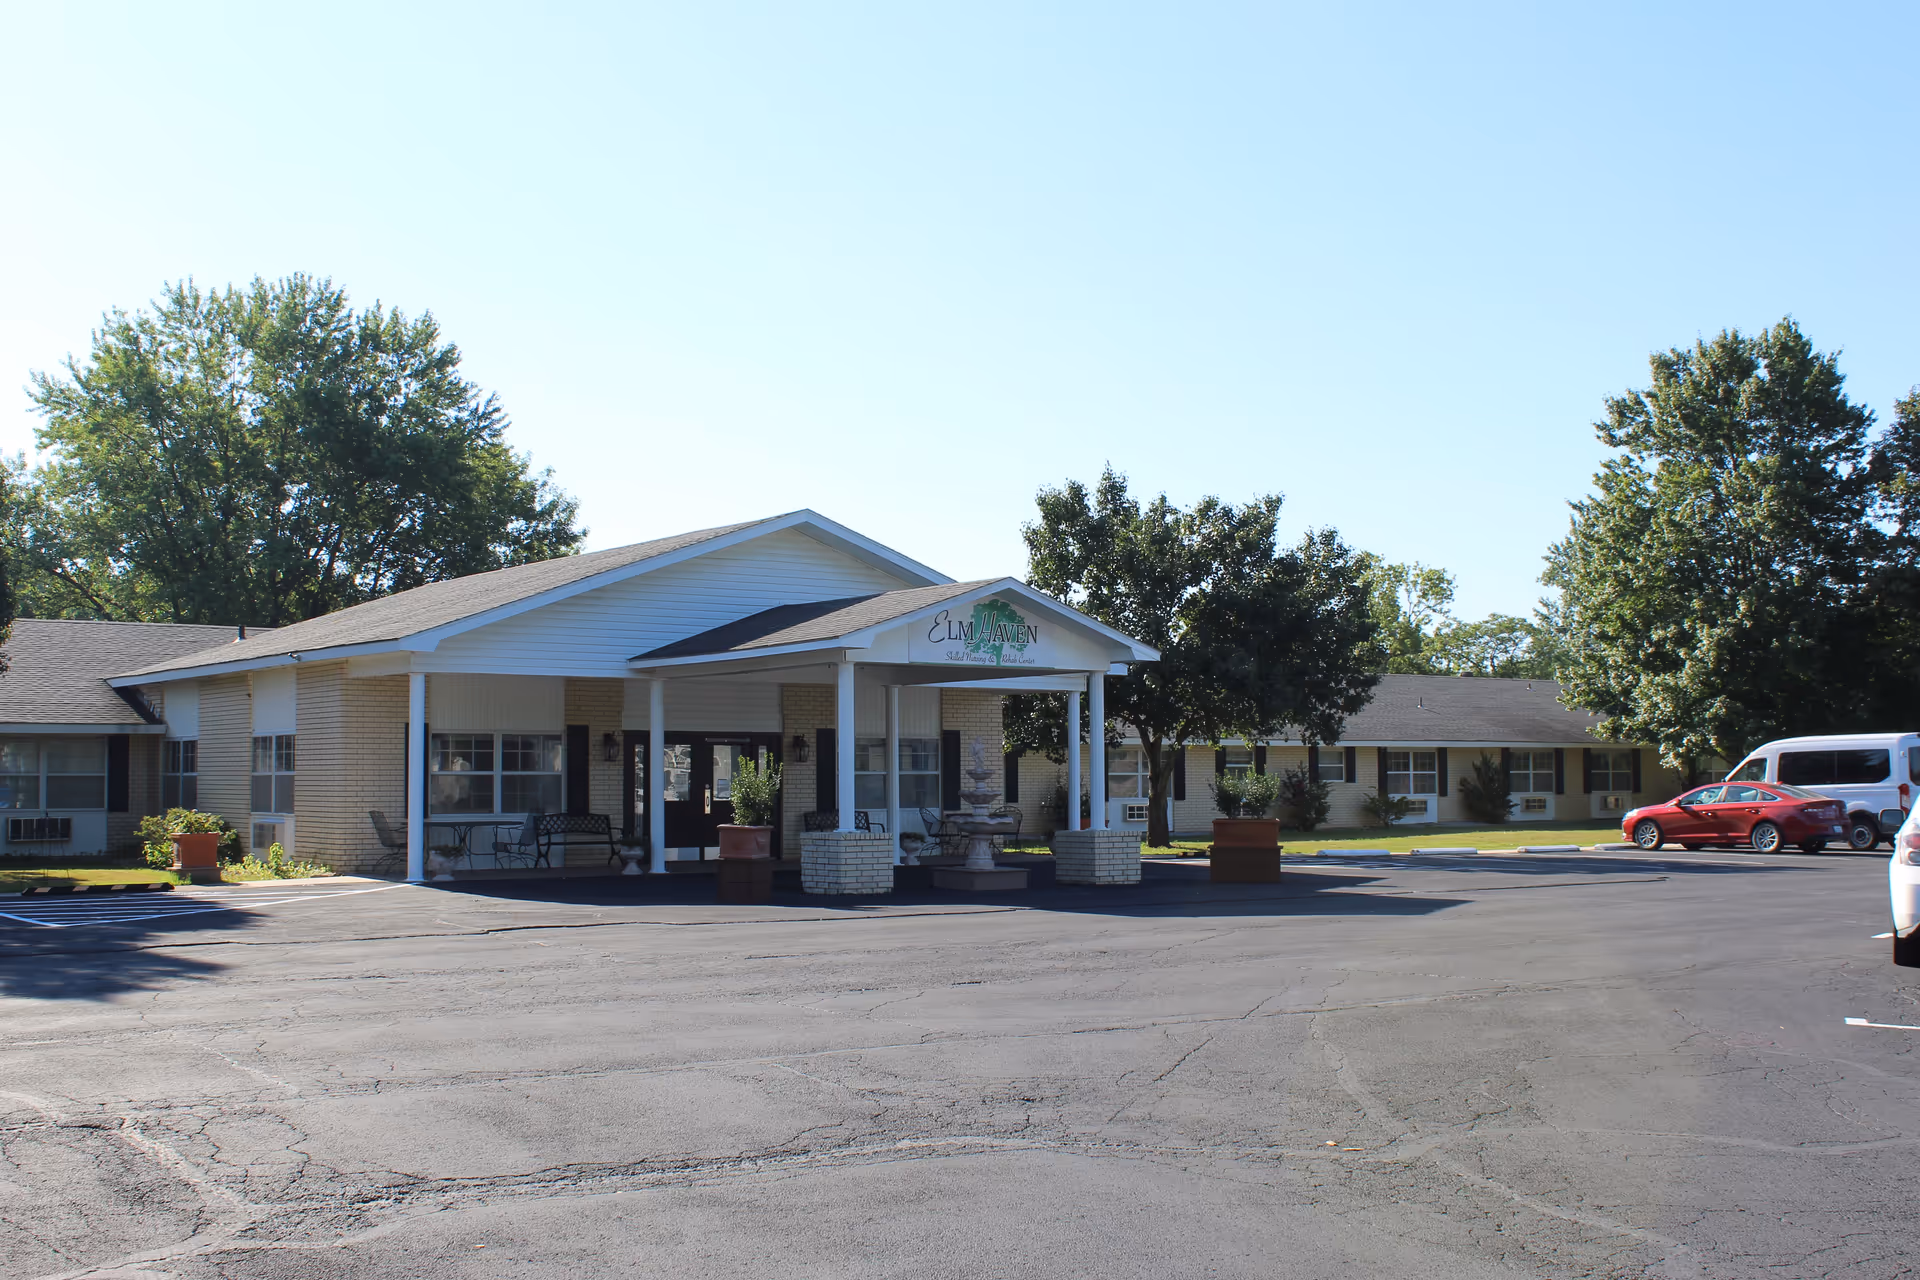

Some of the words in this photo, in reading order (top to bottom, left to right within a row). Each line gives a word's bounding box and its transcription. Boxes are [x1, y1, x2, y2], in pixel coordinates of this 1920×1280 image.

[928, 609, 974, 643] ELM
[967, 611, 1038, 644] HAVEN
[945, 651, 964, 661] Skilled
[966, 652, 986, 664] Nursing
[988, 655, 995, 663] &
[1002, 654, 1017, 664] Rehab
[1018, 654, 1035, 664] Center
